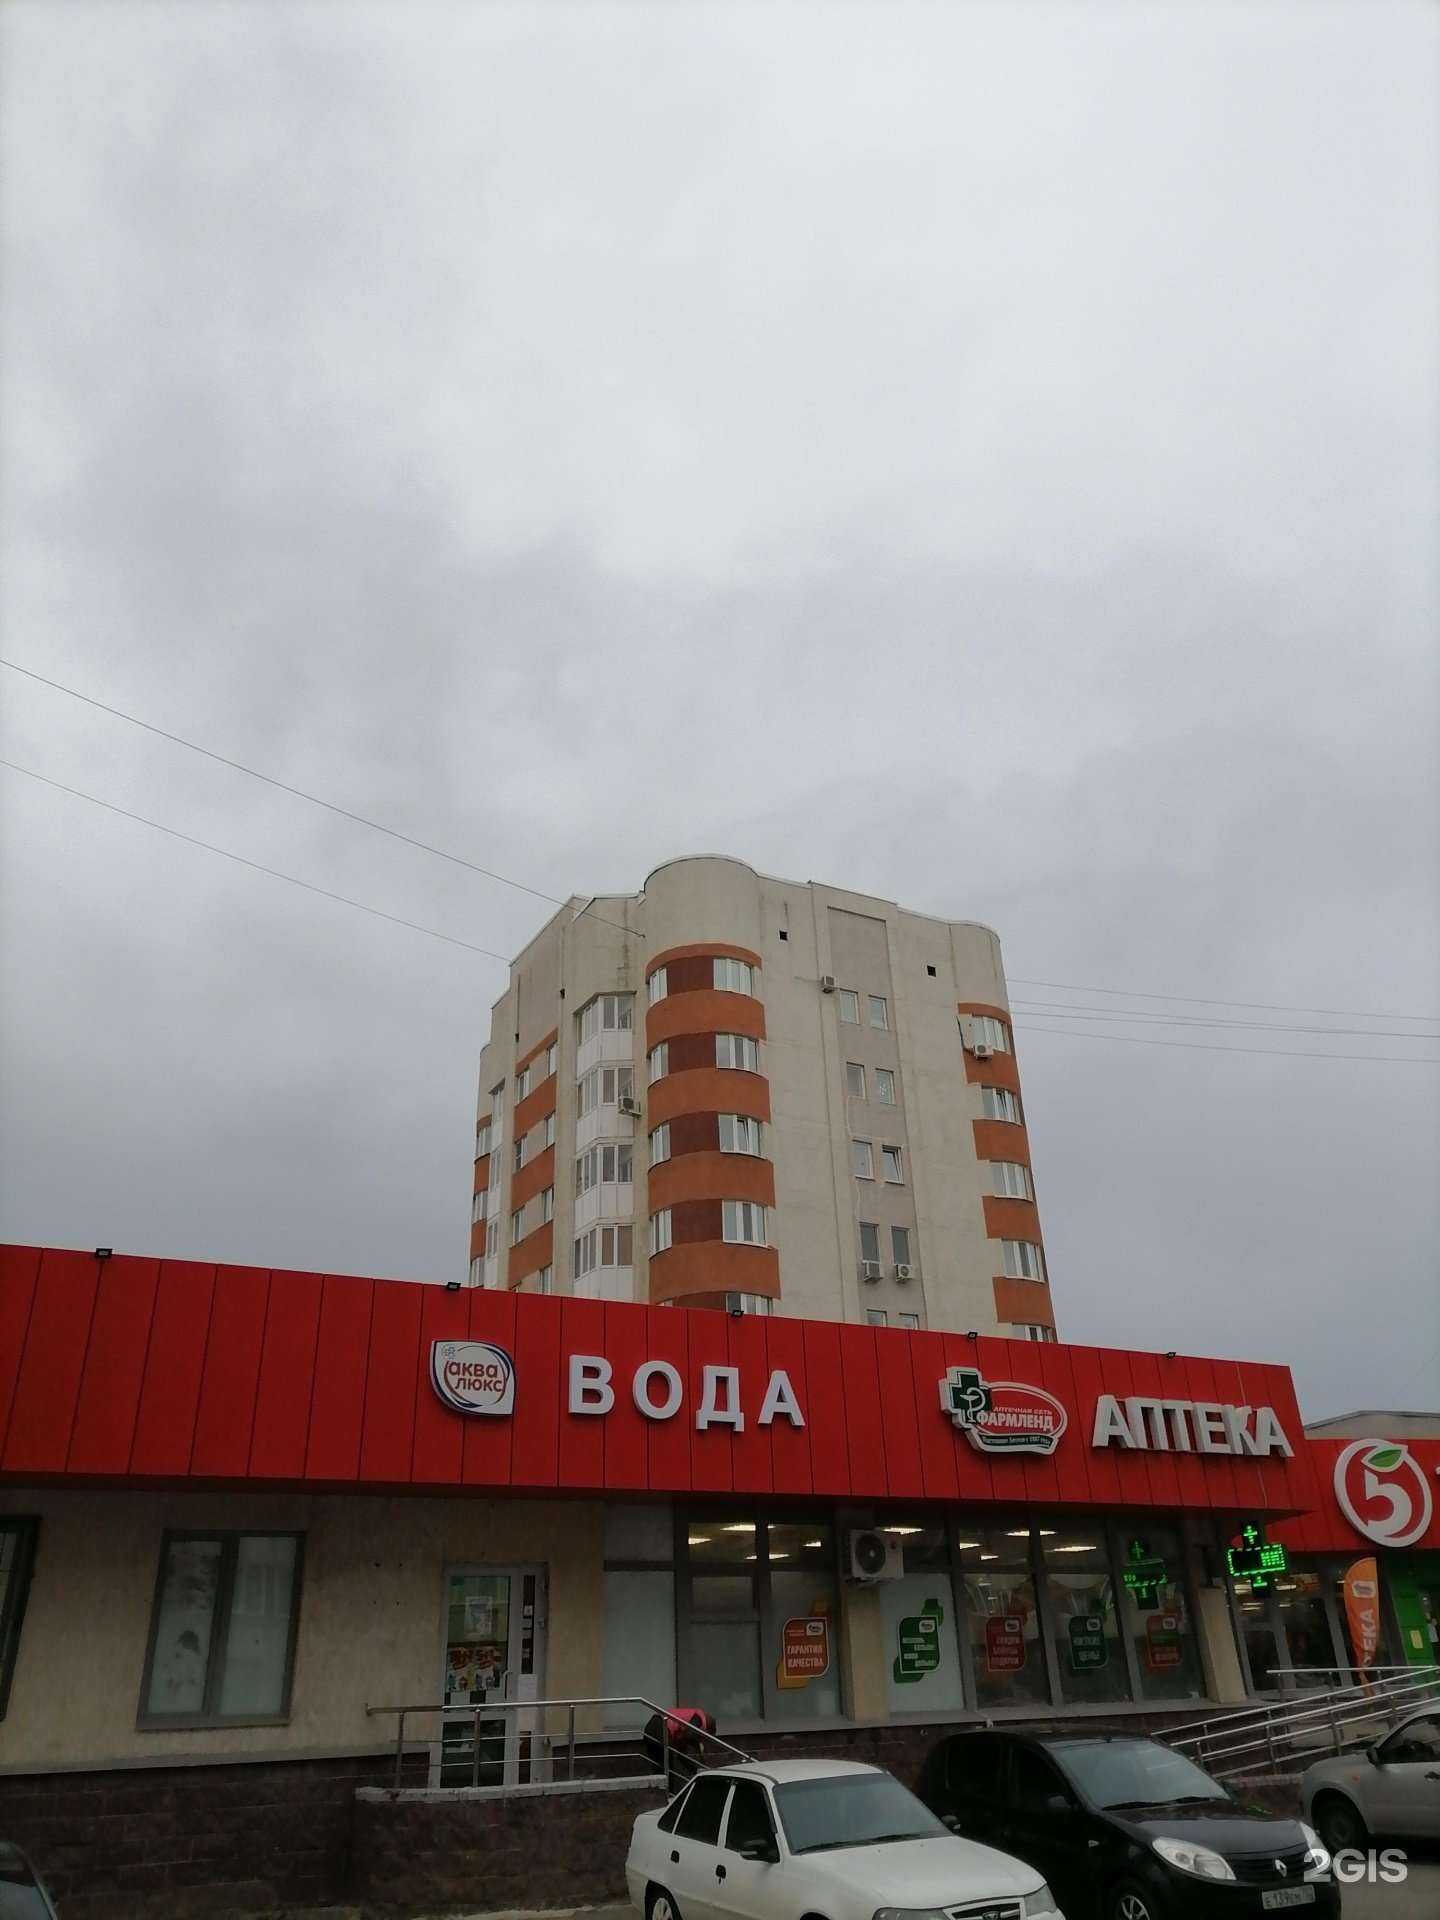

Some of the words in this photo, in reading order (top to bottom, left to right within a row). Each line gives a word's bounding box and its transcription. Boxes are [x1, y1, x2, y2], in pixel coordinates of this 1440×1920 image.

[448, 1361, 498, 1378] аква
[455, 1377, 503, 1392] люкс
[568, 1354, 806, 1432] ВОДА
[976, 1410, 1053, 1432] ФАРМЛЕНД
[1092, 1394, 1295, 1457] АПТЕКА
[1364, 1468, 1412, 1540] 5
[786, 1644, 823, 1655] ГАРАНТИЯ
[787, 1657, 824, 1668] КАЧЕСТВА
